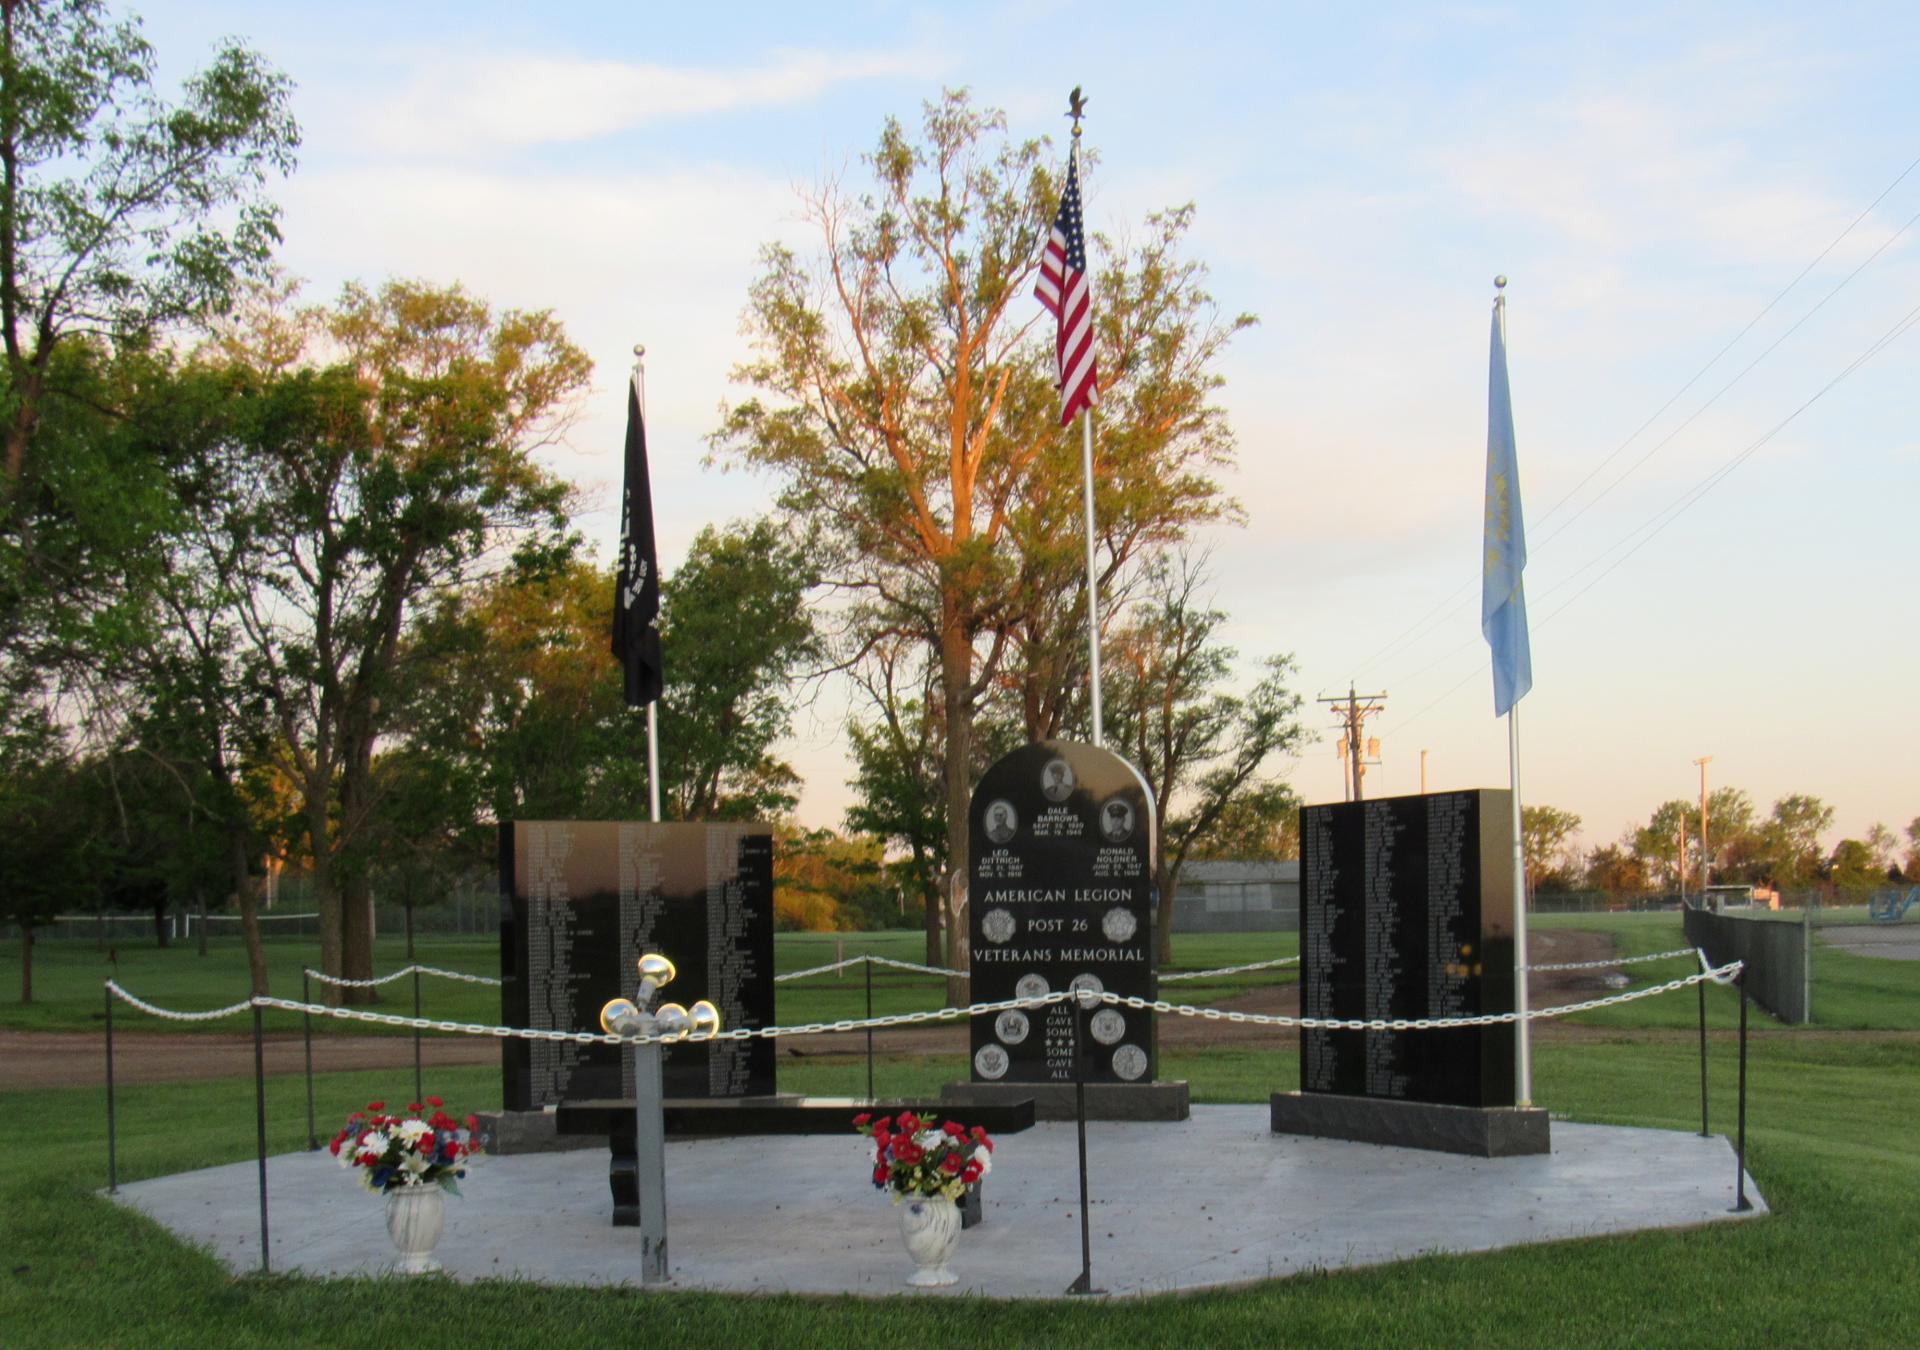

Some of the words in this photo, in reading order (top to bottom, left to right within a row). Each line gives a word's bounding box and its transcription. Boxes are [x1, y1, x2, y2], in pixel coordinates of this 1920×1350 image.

[1047, 807, 1068, 815] DALE
[992, 849, 1009, 857] LEO
[1099, 847, 1134, 855] RONALD
[981, 856, 1020, 864] DITTRICH
[1096, 855, 1137, 863] NOLDNER
[984, 889, 1066, 903] AMERICAN
[1074, 888, 1132, 902] LEGION
[1028, 919, 1064, 932] POST
[1072, 919, 1088, 932] 26
[974, 949, 1051, 962] VETERANS
[1060, 948, 1145, 962] MEMORIAL
[1050, 1005, 1069, 1015] ALL
[1046, 1017, 1073, 1026] GAVE
[1046, 1027, 1074, 1037] SOME
[1046, 1047, 1074, 1057] SOME
[1046, 1058, 1073, 1068] GAVE
[1051, 1069, 1070, 1079] ALL
